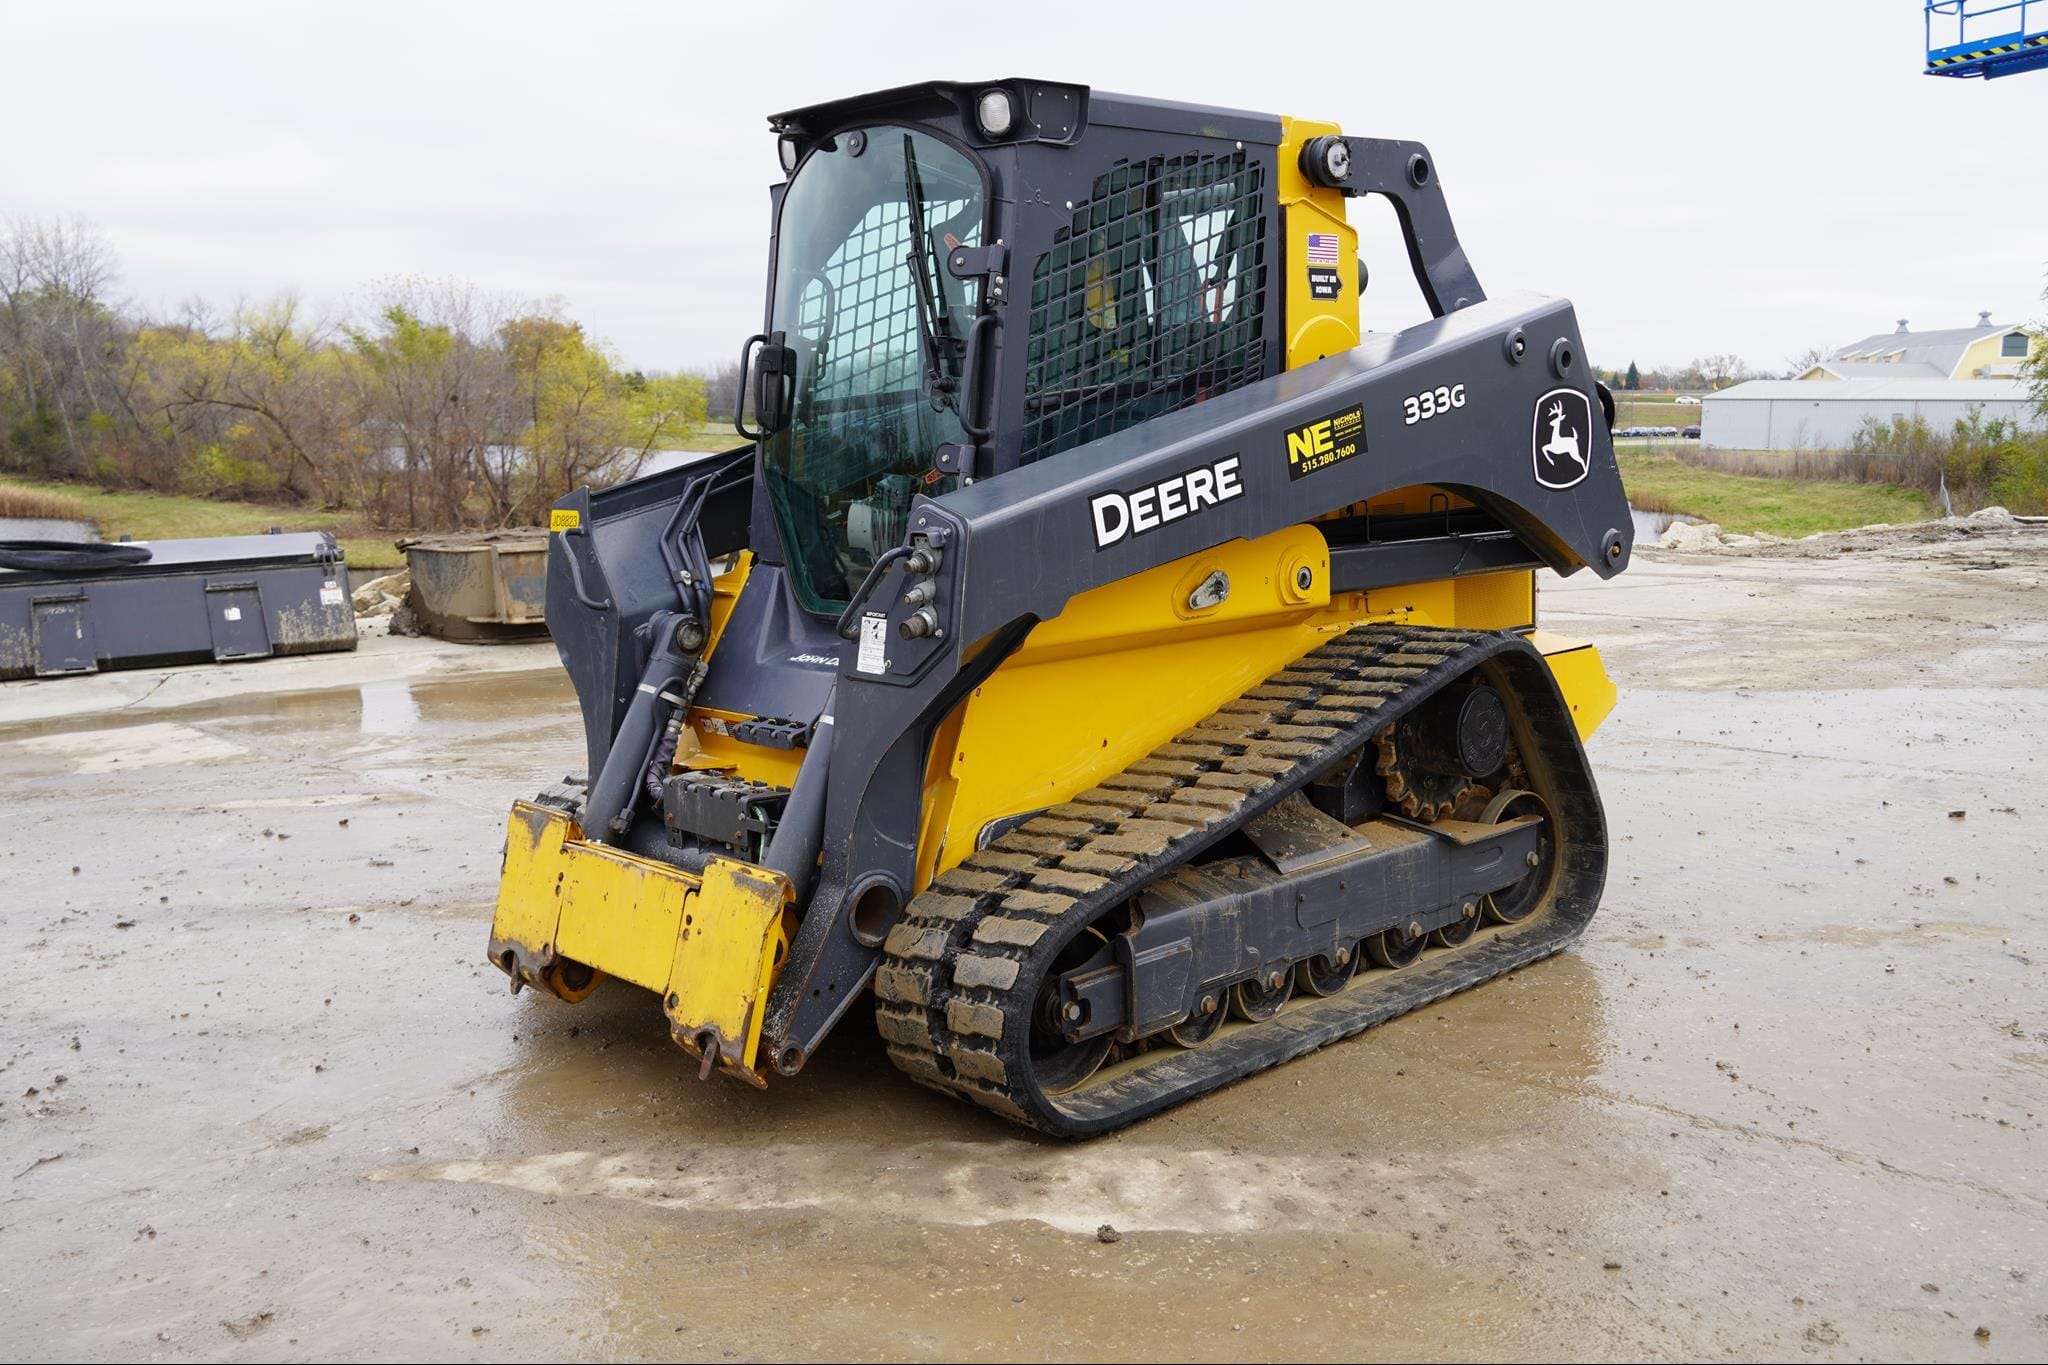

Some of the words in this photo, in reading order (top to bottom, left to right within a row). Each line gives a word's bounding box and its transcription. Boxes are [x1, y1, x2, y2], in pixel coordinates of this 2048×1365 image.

[1311, 274, 1328, 283] BUILT
[1329, 275, 1337, 283] IN
[1333, 410, 1360, 428] NICHOLS
[1404, 384, 1466, 425] 333G
[1287, 419, 1334, 465] NE
[1302, 443, 1356, 473] 515.280.7600
[1091, 457, 1243, 547] DEERE
[787, 653, 829, 664] JOHN
[824, 657, 839, 666] D
